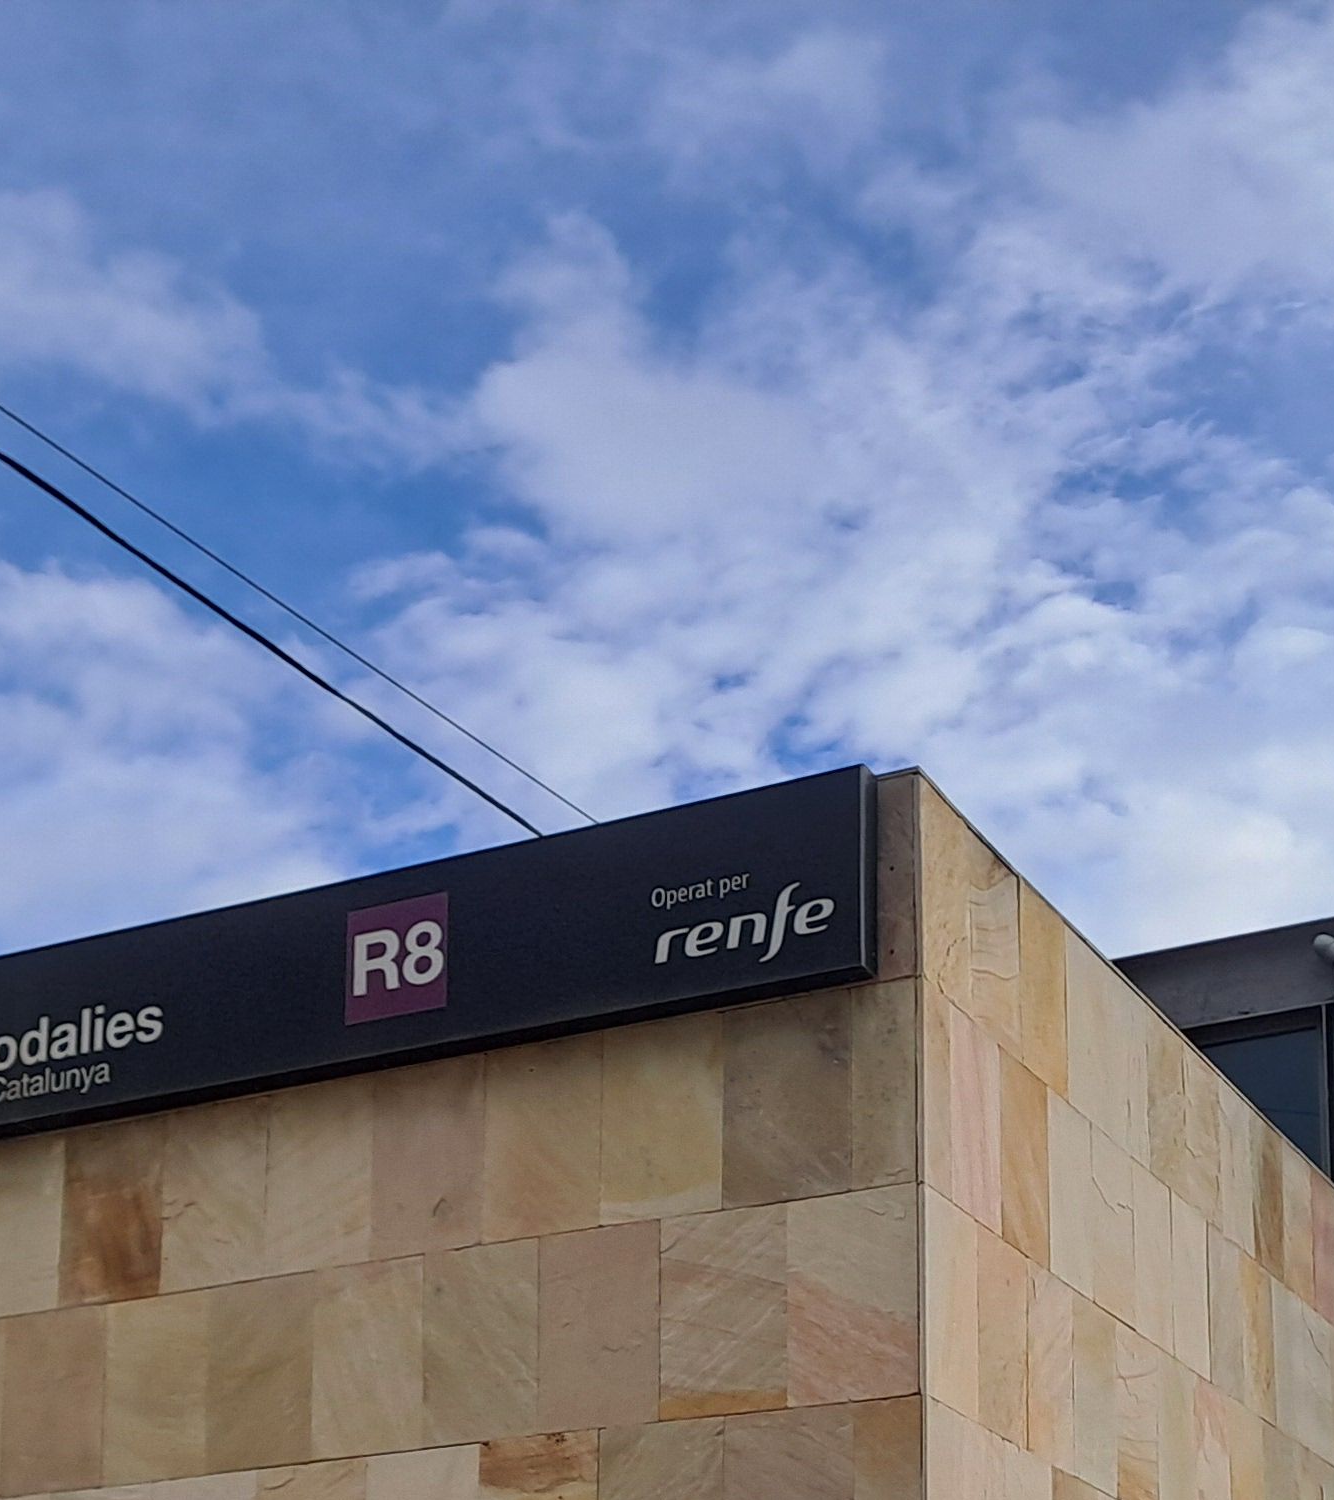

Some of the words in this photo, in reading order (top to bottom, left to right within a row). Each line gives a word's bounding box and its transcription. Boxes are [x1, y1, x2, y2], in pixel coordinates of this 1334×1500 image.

[651, 880, 714, 910] Operat
[719, 873, 750, 899] per
[654, 882, 835, 964] renfe
[352, 920, 445, 997] R8
